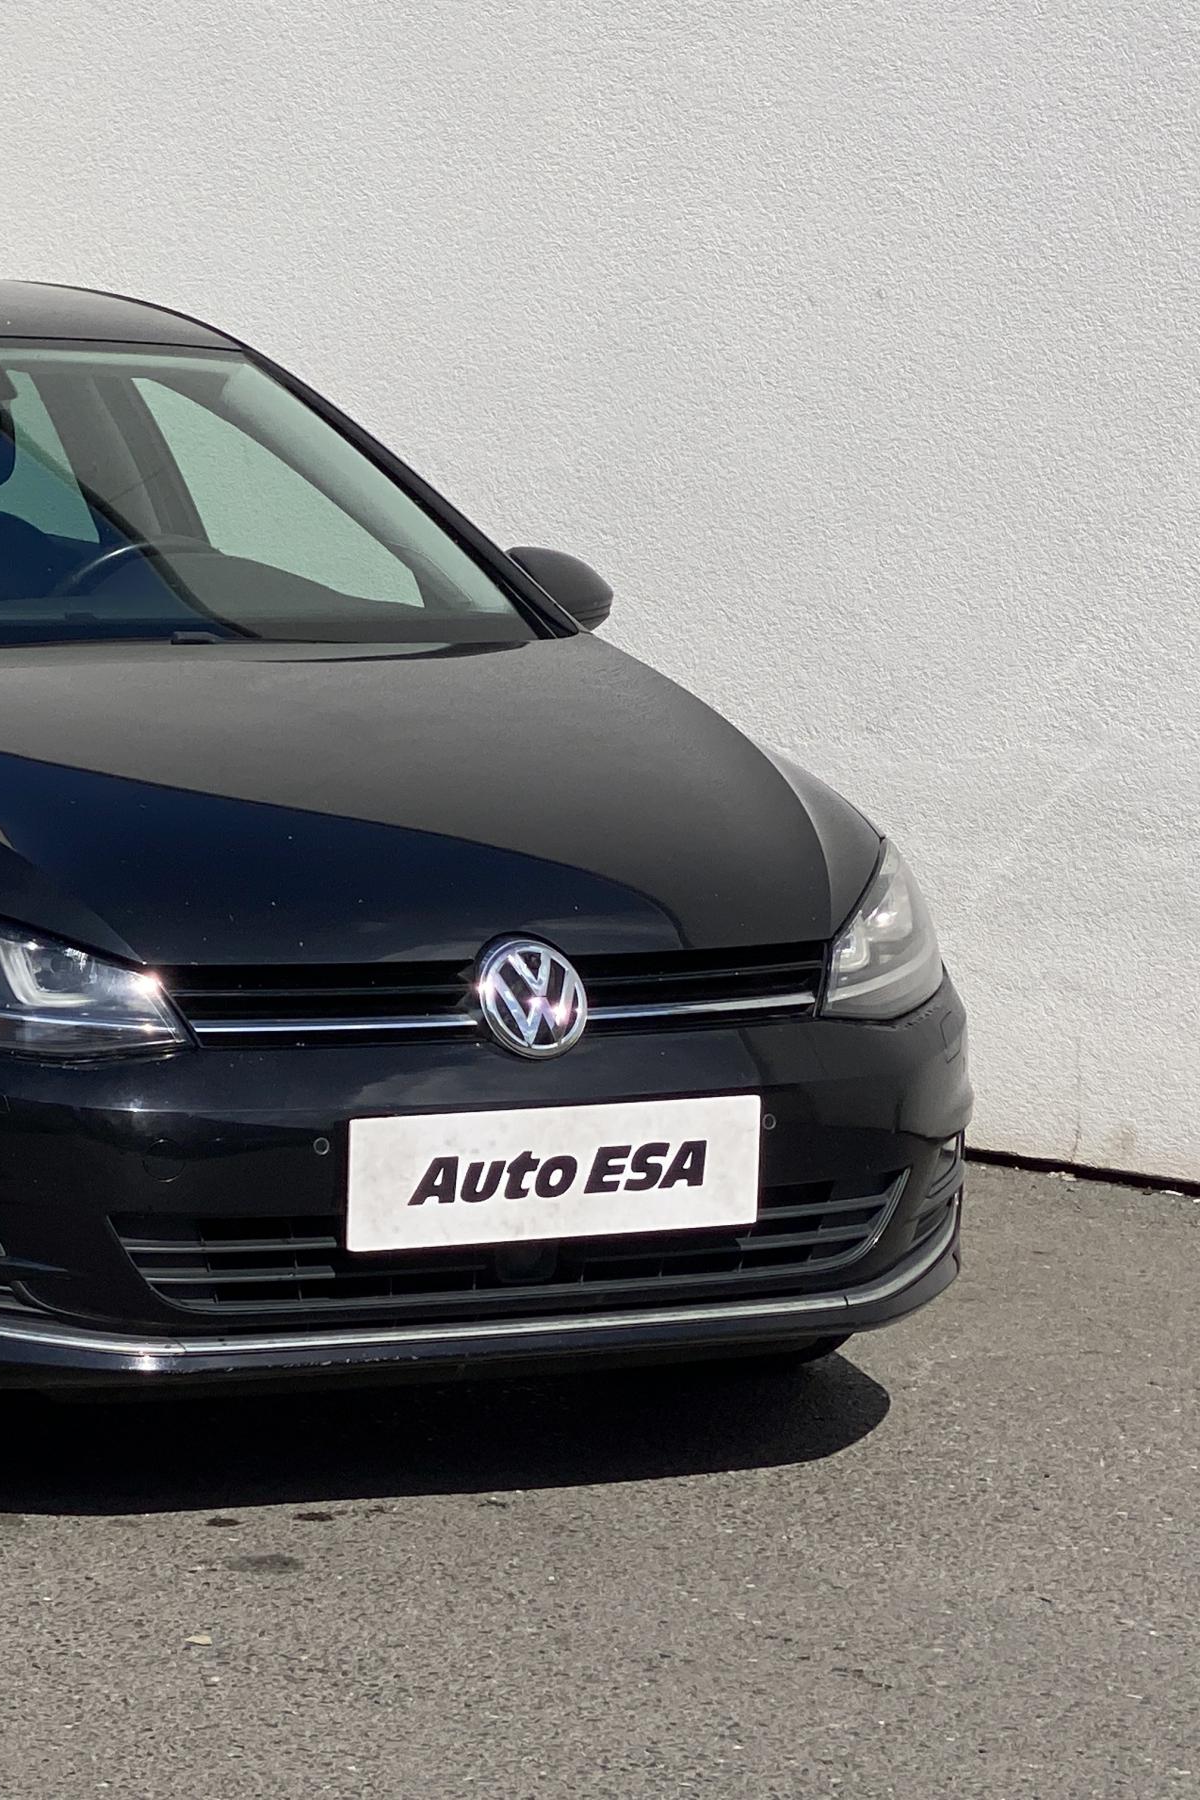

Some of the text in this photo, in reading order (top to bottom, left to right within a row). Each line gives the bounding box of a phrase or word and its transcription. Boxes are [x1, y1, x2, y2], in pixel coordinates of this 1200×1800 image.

[486, 943, 580, 1049] VW
[407, 1139, 707, 1206] Auto ESA
